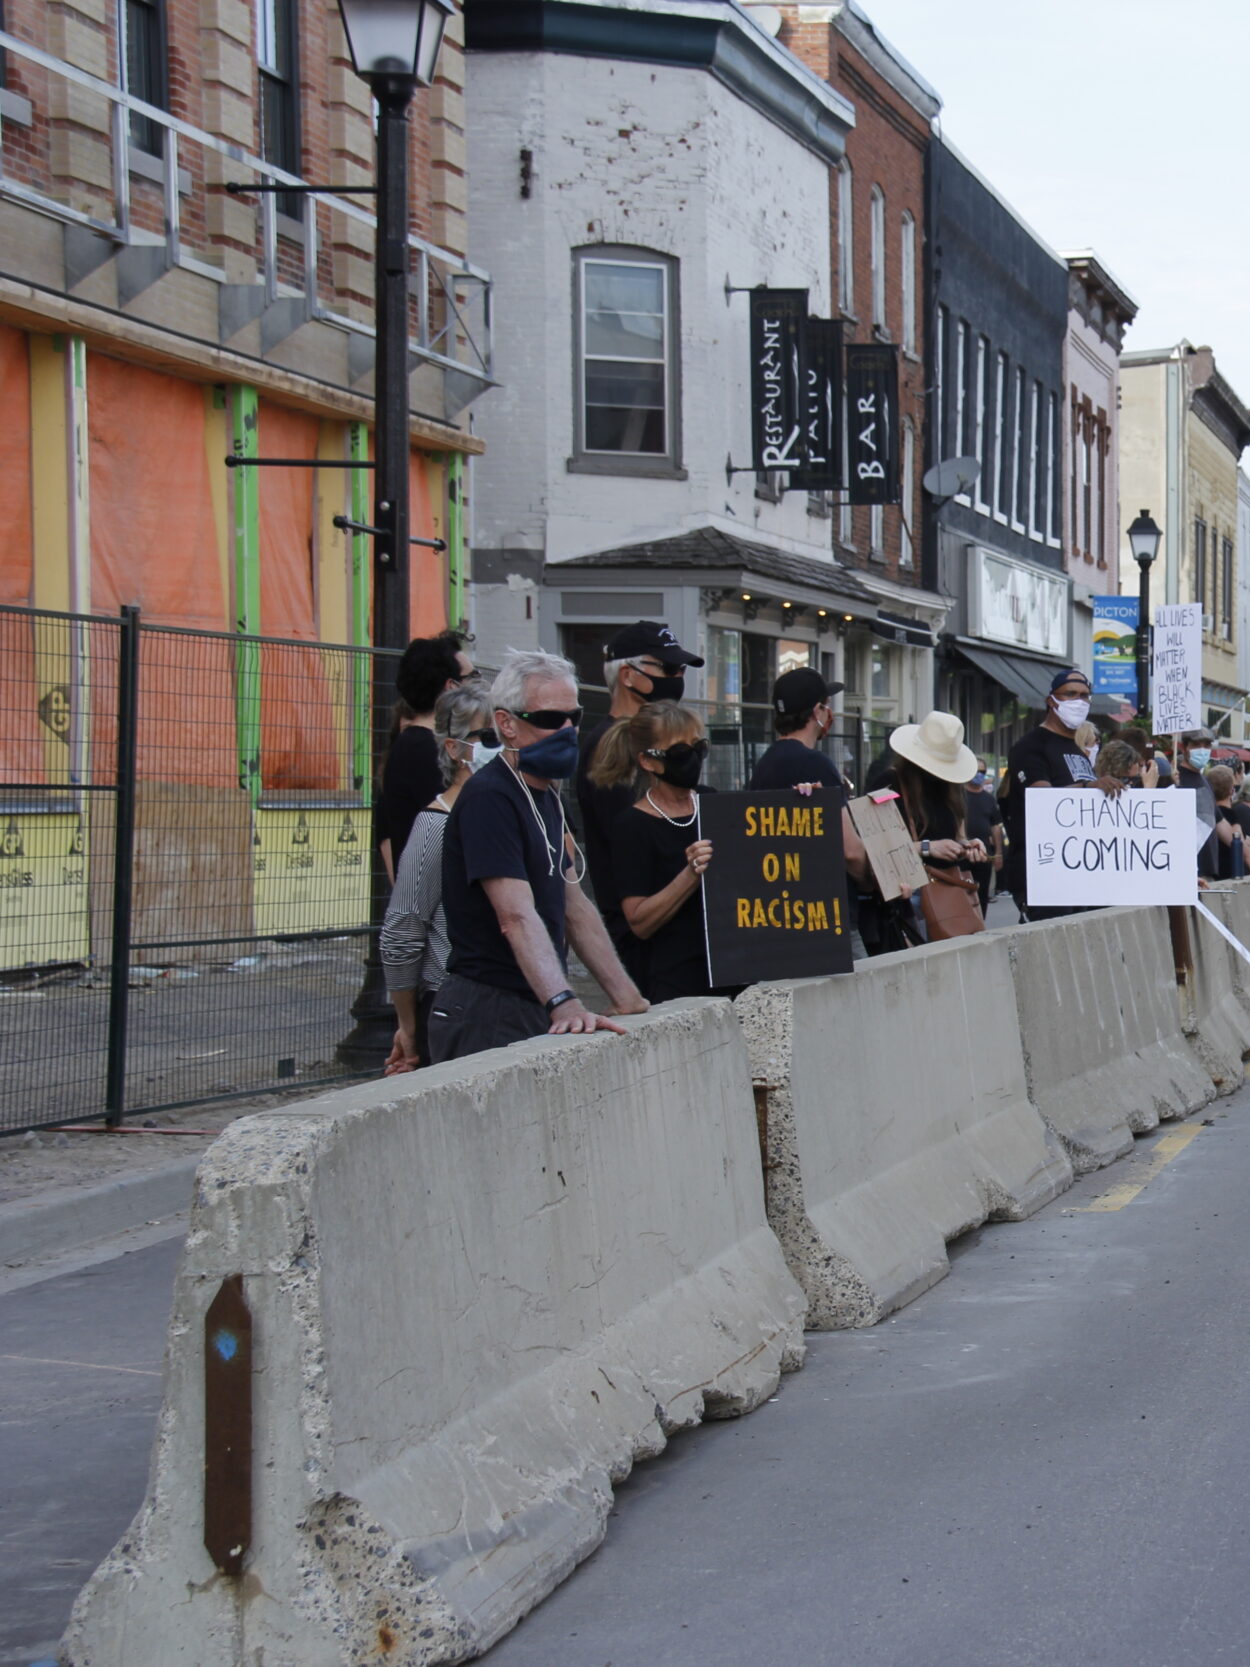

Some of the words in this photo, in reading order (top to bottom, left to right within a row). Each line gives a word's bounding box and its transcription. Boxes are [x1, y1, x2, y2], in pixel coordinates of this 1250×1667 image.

[760, 318, 801, 467] RESTAURANT
[857, 393, 885, 480] BAR
[1094, 606, 1137, 618] PICTON
[1170, 608, 1195, 628] LIVES
[1166, 632, 1183, 646] WILL
[1156, 648, 1186, 668] MATTER
[1165, 666, 1188, 683] WHEN
[1158, 681, 1195, 704] BLACK
[51, 691, 70, 732] GP
[1159, 701, 1187, 718] LIVES
[1156, 713, 1193, 735] MATTER
[745, 806, 824, 837] SHAME
[1055, 797, 1168, 830] CHANGE
[1038, 842, 1055, 859] IS
[1061, 836, 1171, 872] COMING
[762, 853, 800, 882] ON
